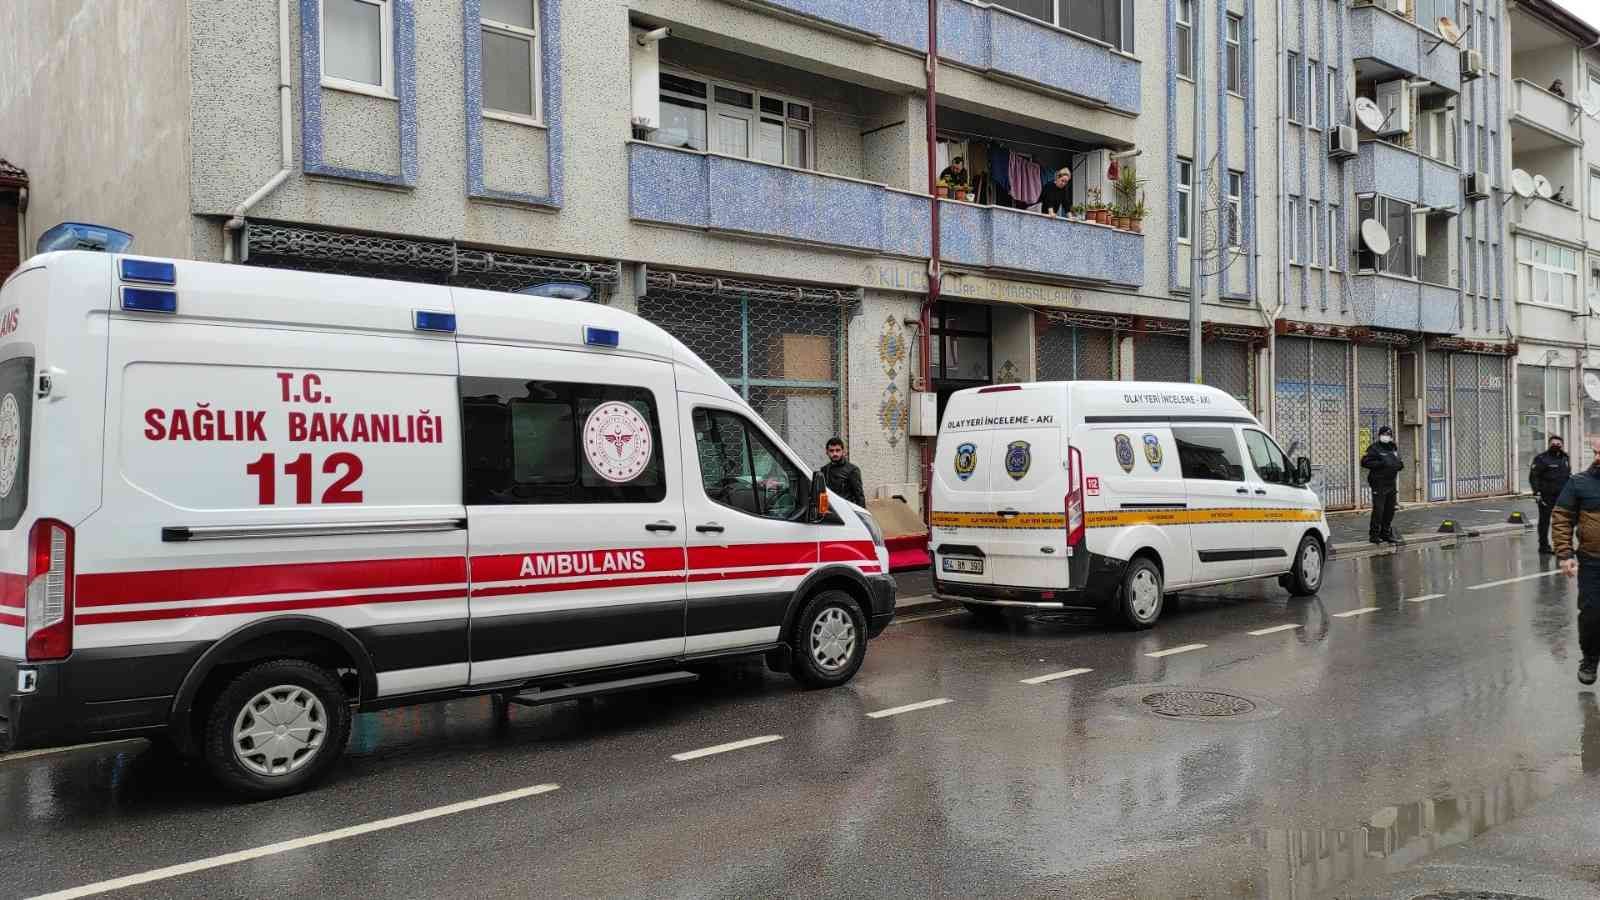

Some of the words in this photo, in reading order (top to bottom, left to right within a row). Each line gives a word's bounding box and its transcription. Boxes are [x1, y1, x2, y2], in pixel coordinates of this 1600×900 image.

[276, 372, 332, 403] T.C.
[144, 401, 267, 441] SAĞLIK
[288, 409, 443, 443] BAKANLIĞI
[947, 419, 965, 429] OLAY
[966, 417, 983, 427] YERİ
[984, 415, 1028, 425] İNCELEME
[246, 451, 364, 505] 112
[1088, 478, 1098, 489] 112
[519, 550, 646, 577] AMBULANS
